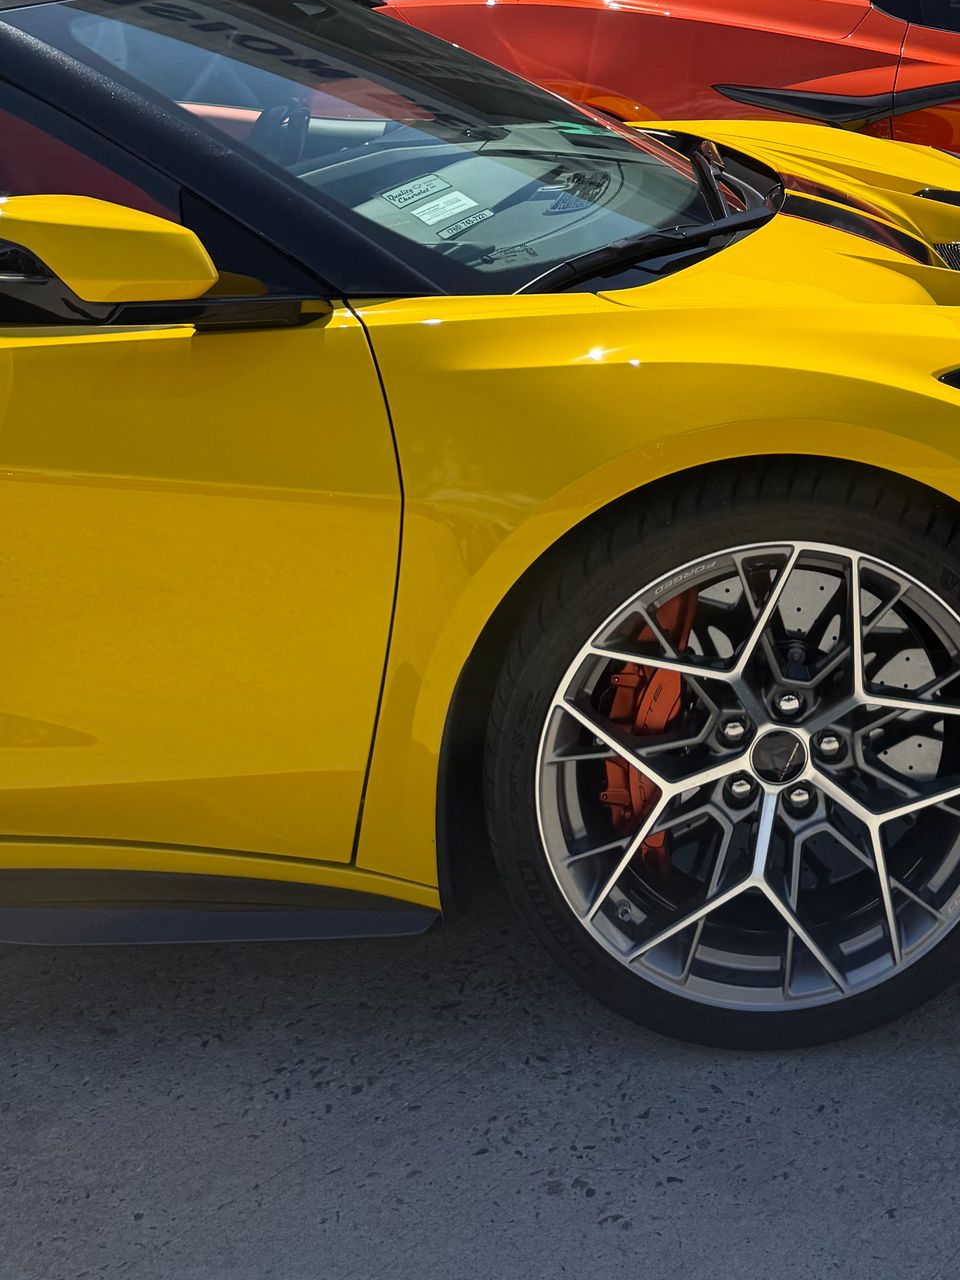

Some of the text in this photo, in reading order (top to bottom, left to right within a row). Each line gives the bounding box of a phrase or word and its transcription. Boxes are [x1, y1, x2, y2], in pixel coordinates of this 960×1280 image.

[386, 188, 413, 201] Quality
[397, 187, 430, 204] Chevrolet
[655, 561, 716, 595] FORGED
